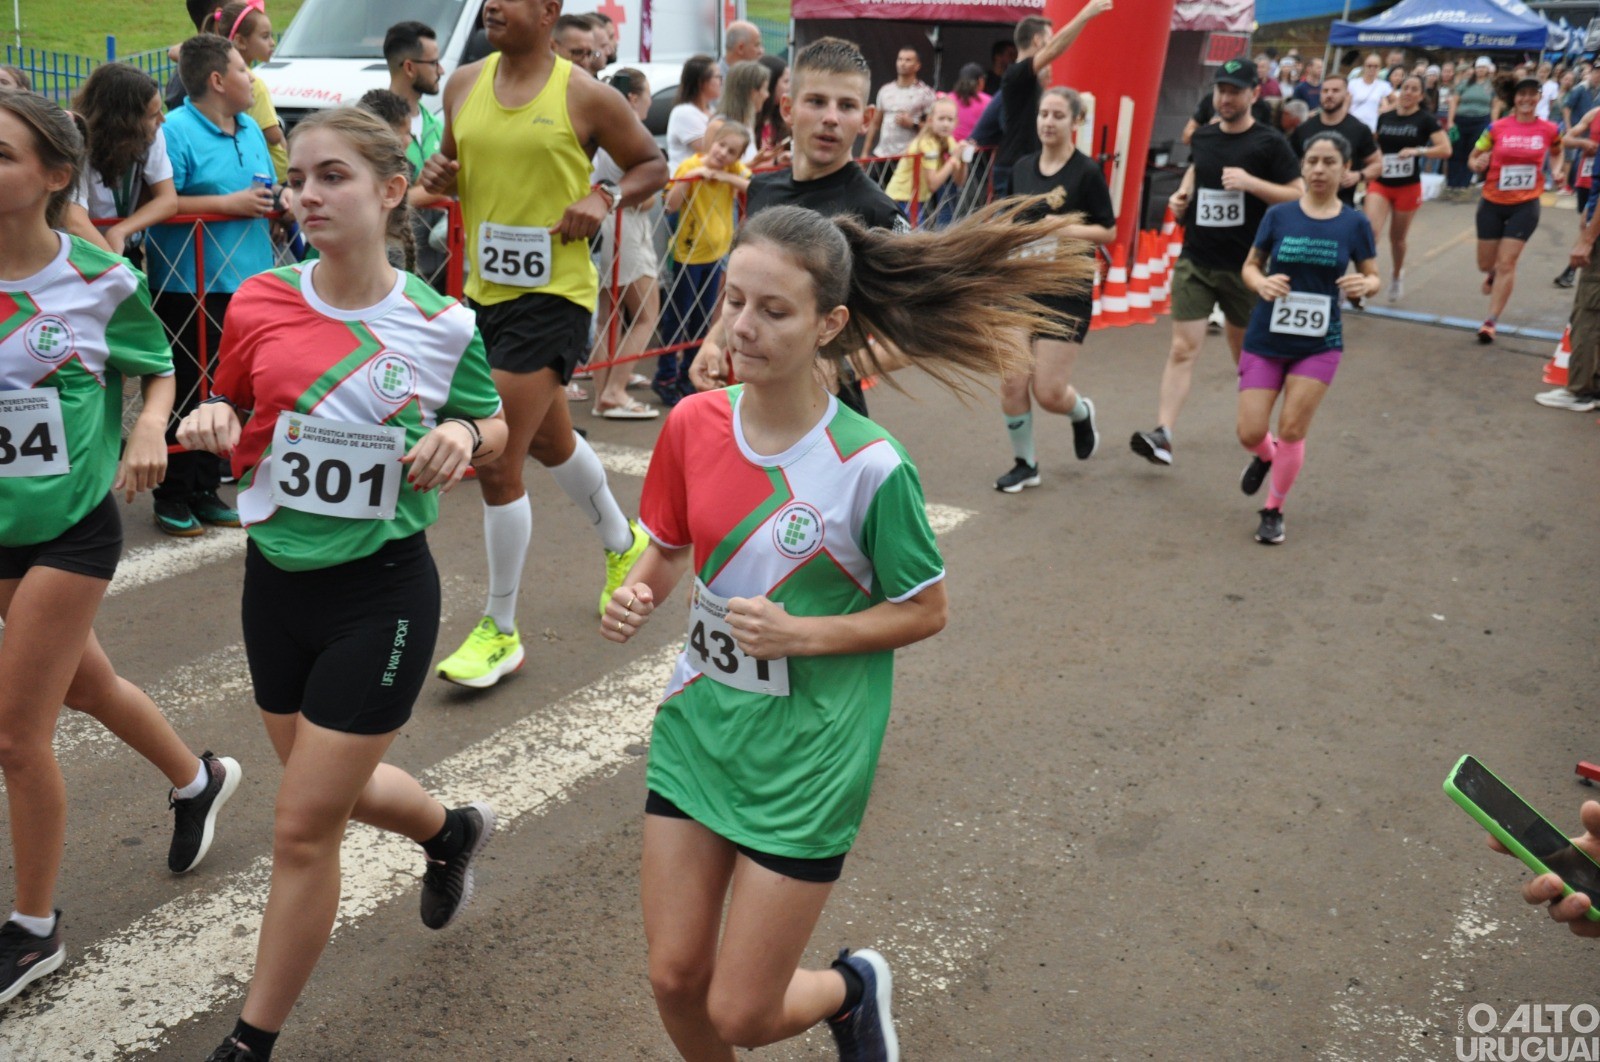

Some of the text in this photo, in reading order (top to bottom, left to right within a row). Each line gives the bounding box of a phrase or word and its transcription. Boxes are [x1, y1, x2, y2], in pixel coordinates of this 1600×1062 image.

[1385, 163, 1411, 174] 216
[1503, 174, 1533, 186] 237
[1200, 204, 1240, 221] 338
[483, 246, 545, 278] 256
[1276, 307, 1325, 329] 259
[15, 403, 49, 411] ALPESTRE
[302, 433, 396, 450] ANIVERSÁRIO DE ALPESTRE
[303, 425, 396, 443] XXIX RÚSTICA INTERESTADUAL
[278, 451, 386, 507] 301
[381, 618, 410, 687] LIFE WAY SPORT
